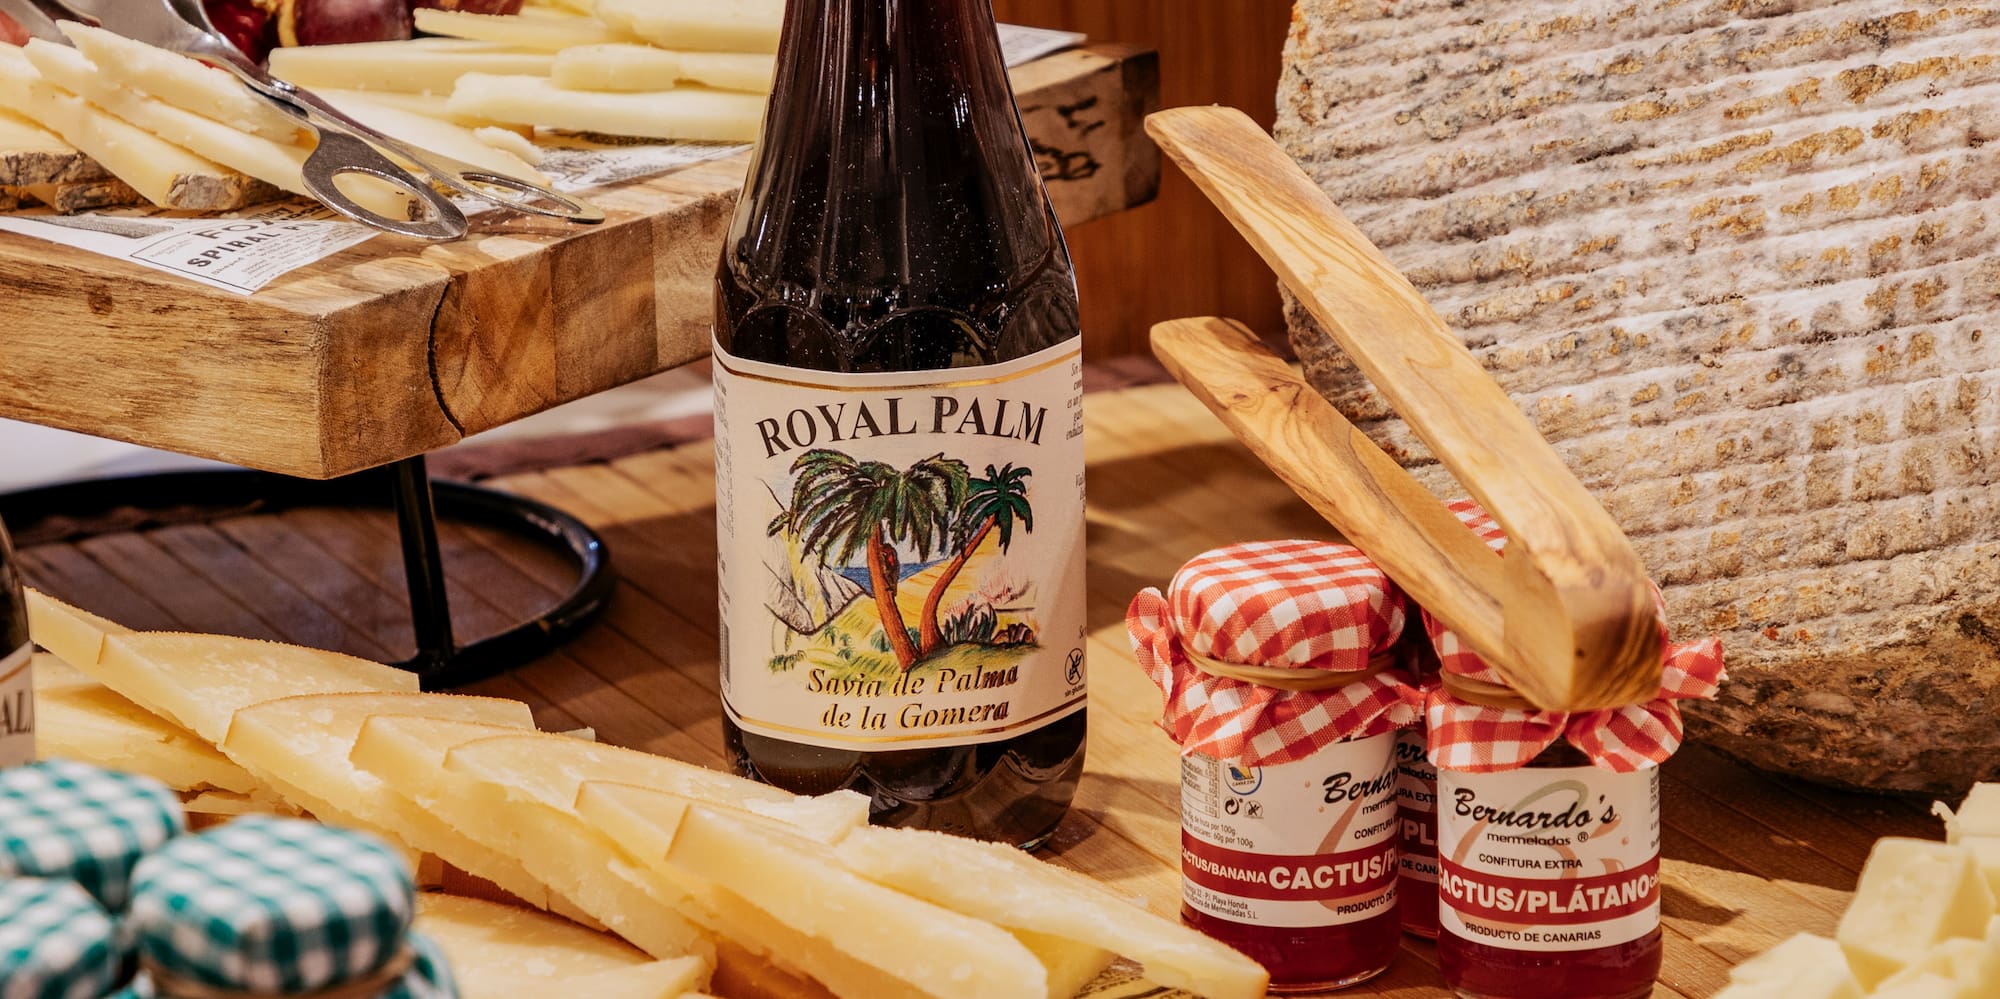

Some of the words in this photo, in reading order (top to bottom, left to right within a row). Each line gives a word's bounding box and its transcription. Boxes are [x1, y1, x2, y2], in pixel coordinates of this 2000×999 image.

[187, 232, 281, 268] SPIRAL
[755, 397, 917, 459] ROYAL
[929, 395, 1049, 446] PALM
[807, 667, 882, 698] Savia
[890, 671, 924, 696] de
[934, 663, 1018, 694] Palma
[821, 702, 851, 729] de
[861, 705, 887, 731] la
[896, 698, 1009, 730] Gomera
[1454, 788, 1617, 829] Bernardo's
[1354, 818, 1393, 840] CONFITURA
[1487, 832, 1571, 846] mermeladas
[1479, 853, 1541, 869] CONFITURA
[1545, 858, 1583, 869] EXTRA
[1227, 899, 1249, 910] Honda
[1337, 894, 1385, 916] PRODUCTO
[1465, 922, 1521, 941] PRODUCTO
[1524, 932, 1540, 943] DE
[1543, 930, 1602, 943] CANARIAS
